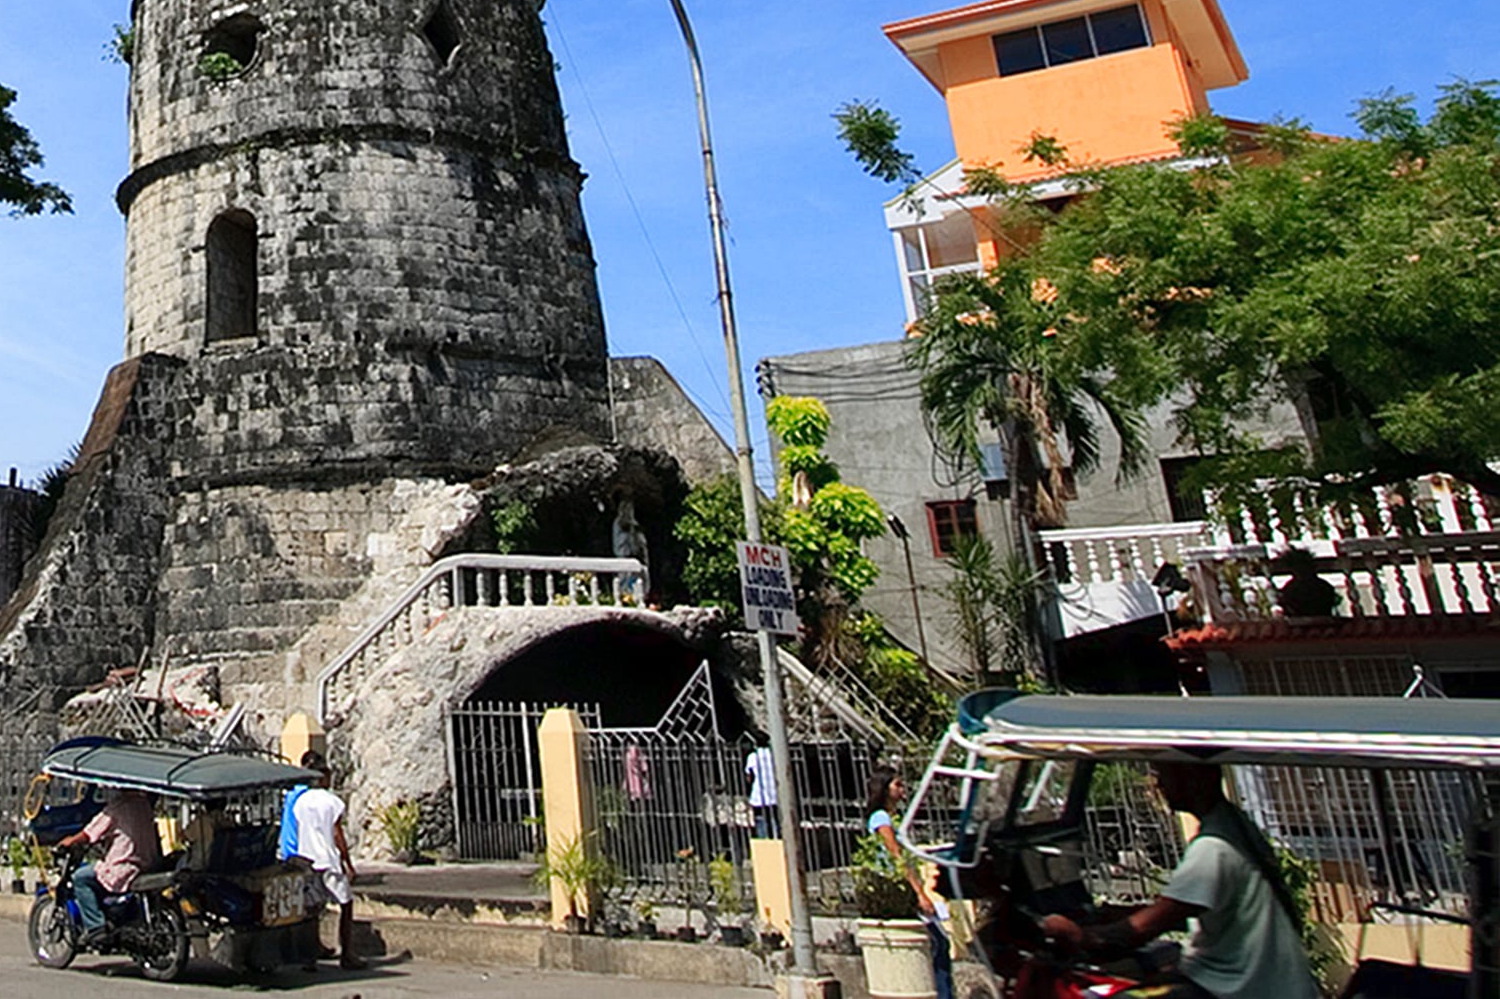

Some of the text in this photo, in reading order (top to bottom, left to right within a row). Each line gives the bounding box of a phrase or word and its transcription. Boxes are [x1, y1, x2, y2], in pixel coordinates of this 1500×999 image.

[745, 545, 782, 567] MCH
[745, 565, 787, 589] LOADING
[745, 586, 793, 611] UNLOADING
[759, 609, 783, 630] ONLY
